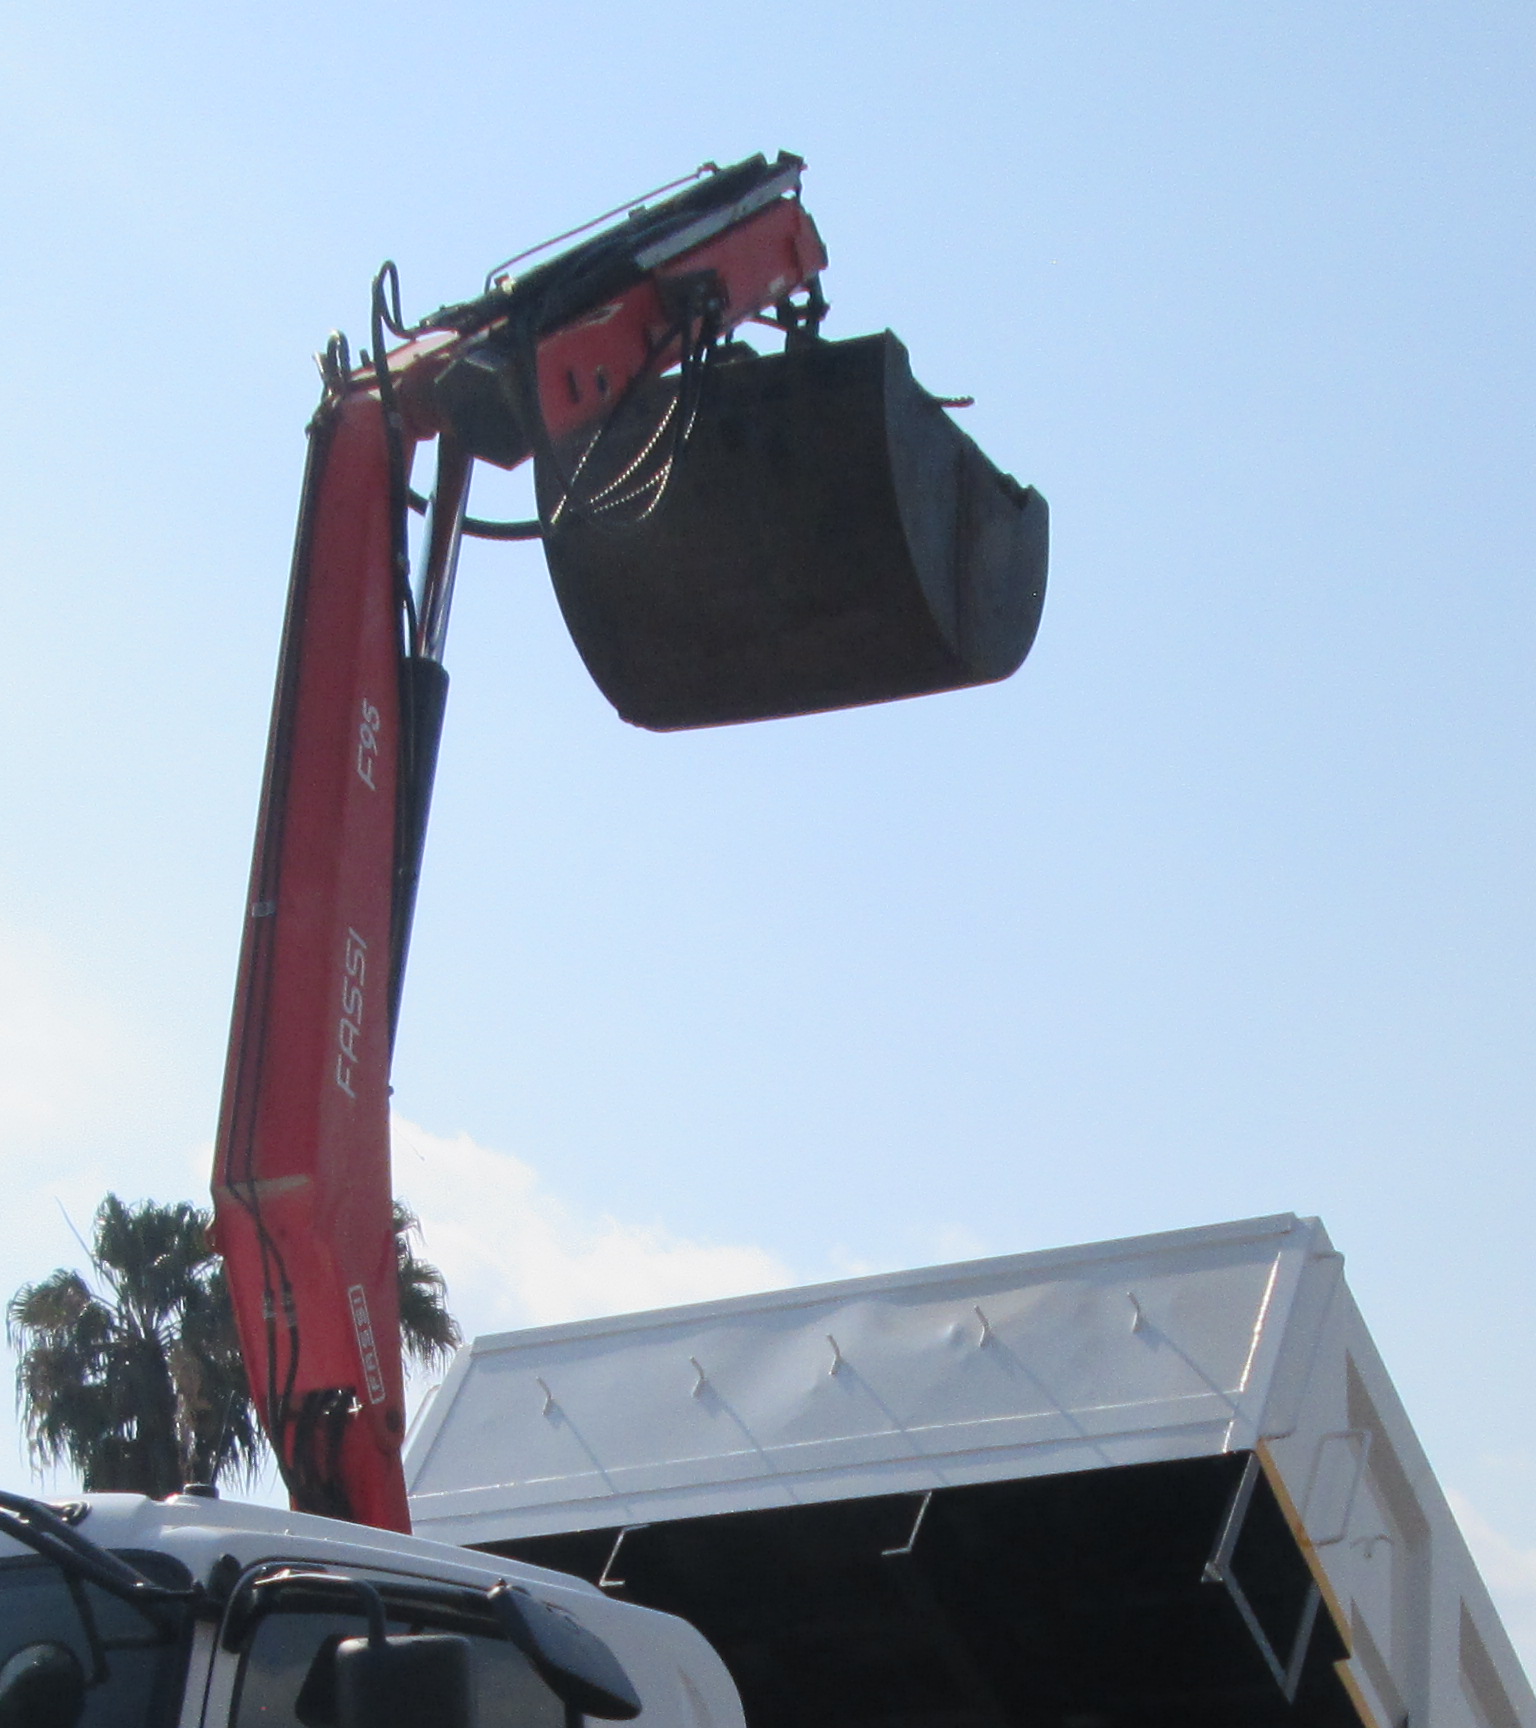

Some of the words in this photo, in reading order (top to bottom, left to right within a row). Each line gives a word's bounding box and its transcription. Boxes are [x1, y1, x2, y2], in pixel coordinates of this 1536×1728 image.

[357, 697, 380, 791] F95
[336, 926, 367, 1098] FASSI
[351, 1295, 382, 1393] FASSI
